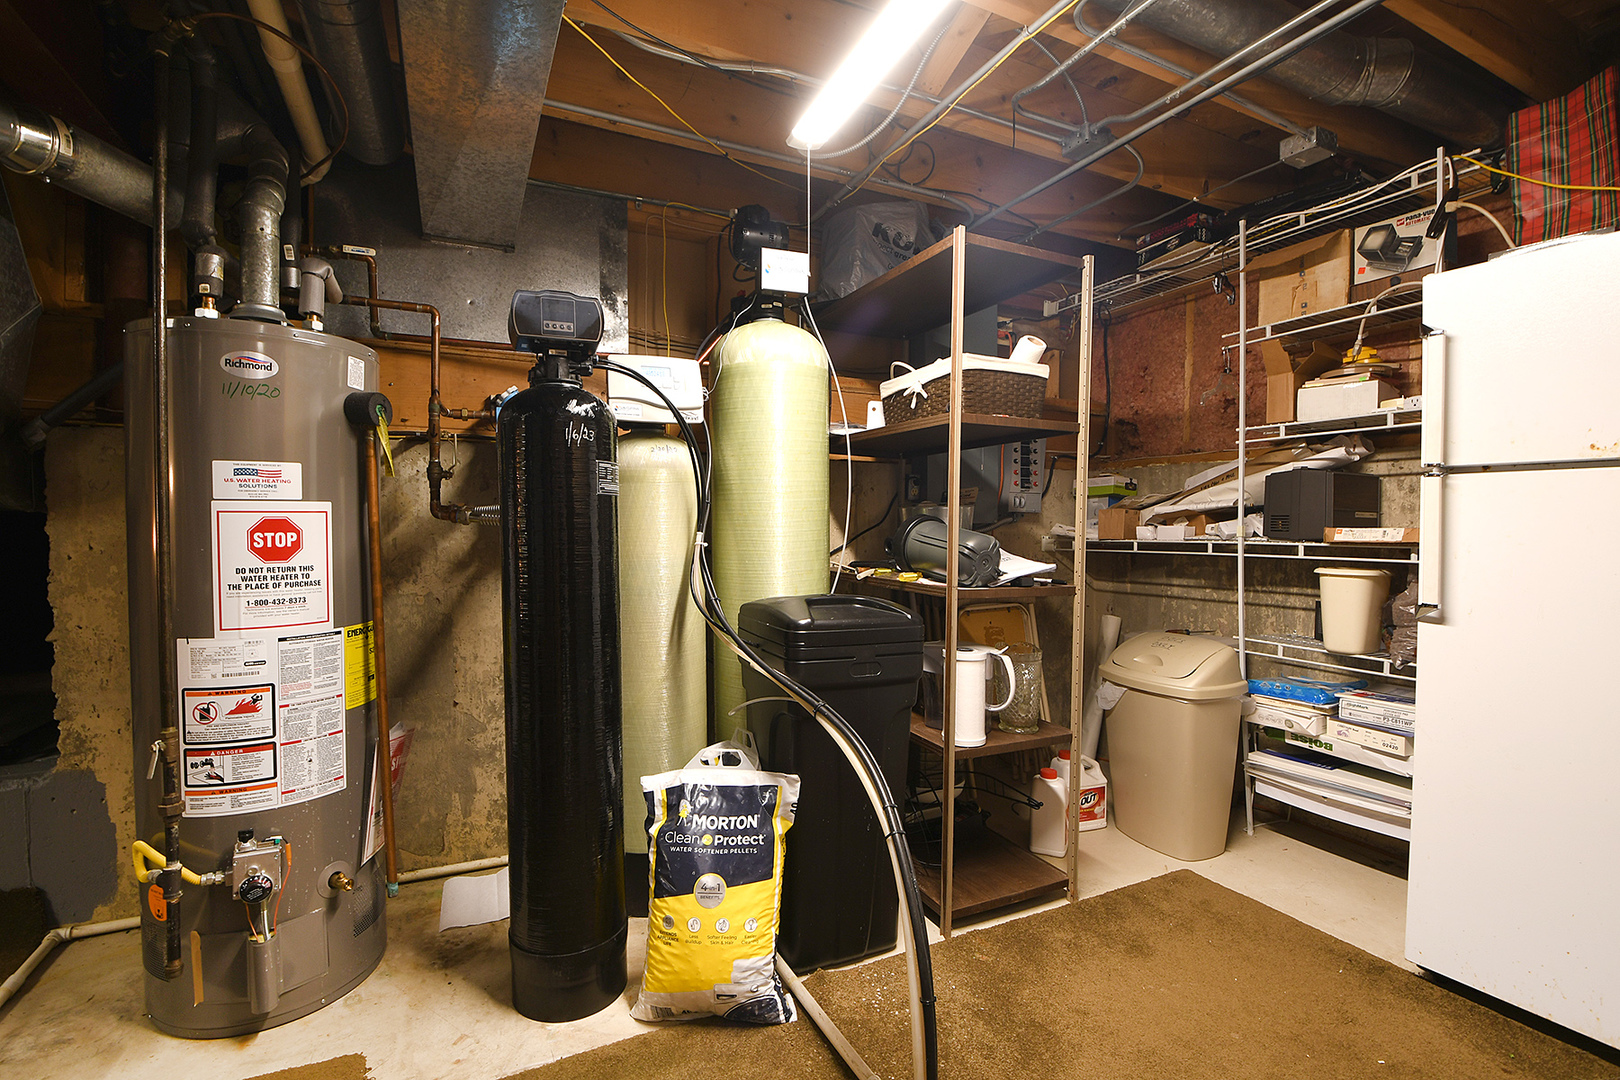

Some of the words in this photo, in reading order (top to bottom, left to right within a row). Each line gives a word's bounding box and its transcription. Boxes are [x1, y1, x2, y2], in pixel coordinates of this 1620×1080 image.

[224, 358, 272, 371] Richmond
[222, 382, 280, 400] 11/10/20
[565, 421, 594, 447] 1/6/23
[253, 532, 297, 548] STOP
[284, 580, 321, 588] PURCHASE
[246, 597, 307, 606] 1-800-432-8373
[1382, 742, 1398, 750] 02420
[1081, 792, 1097, 806] OUT
[692, 814, 758, 830] MORTON
[665, 831, 700, 844] Clean
[714, 834, 765, 846] Protect
